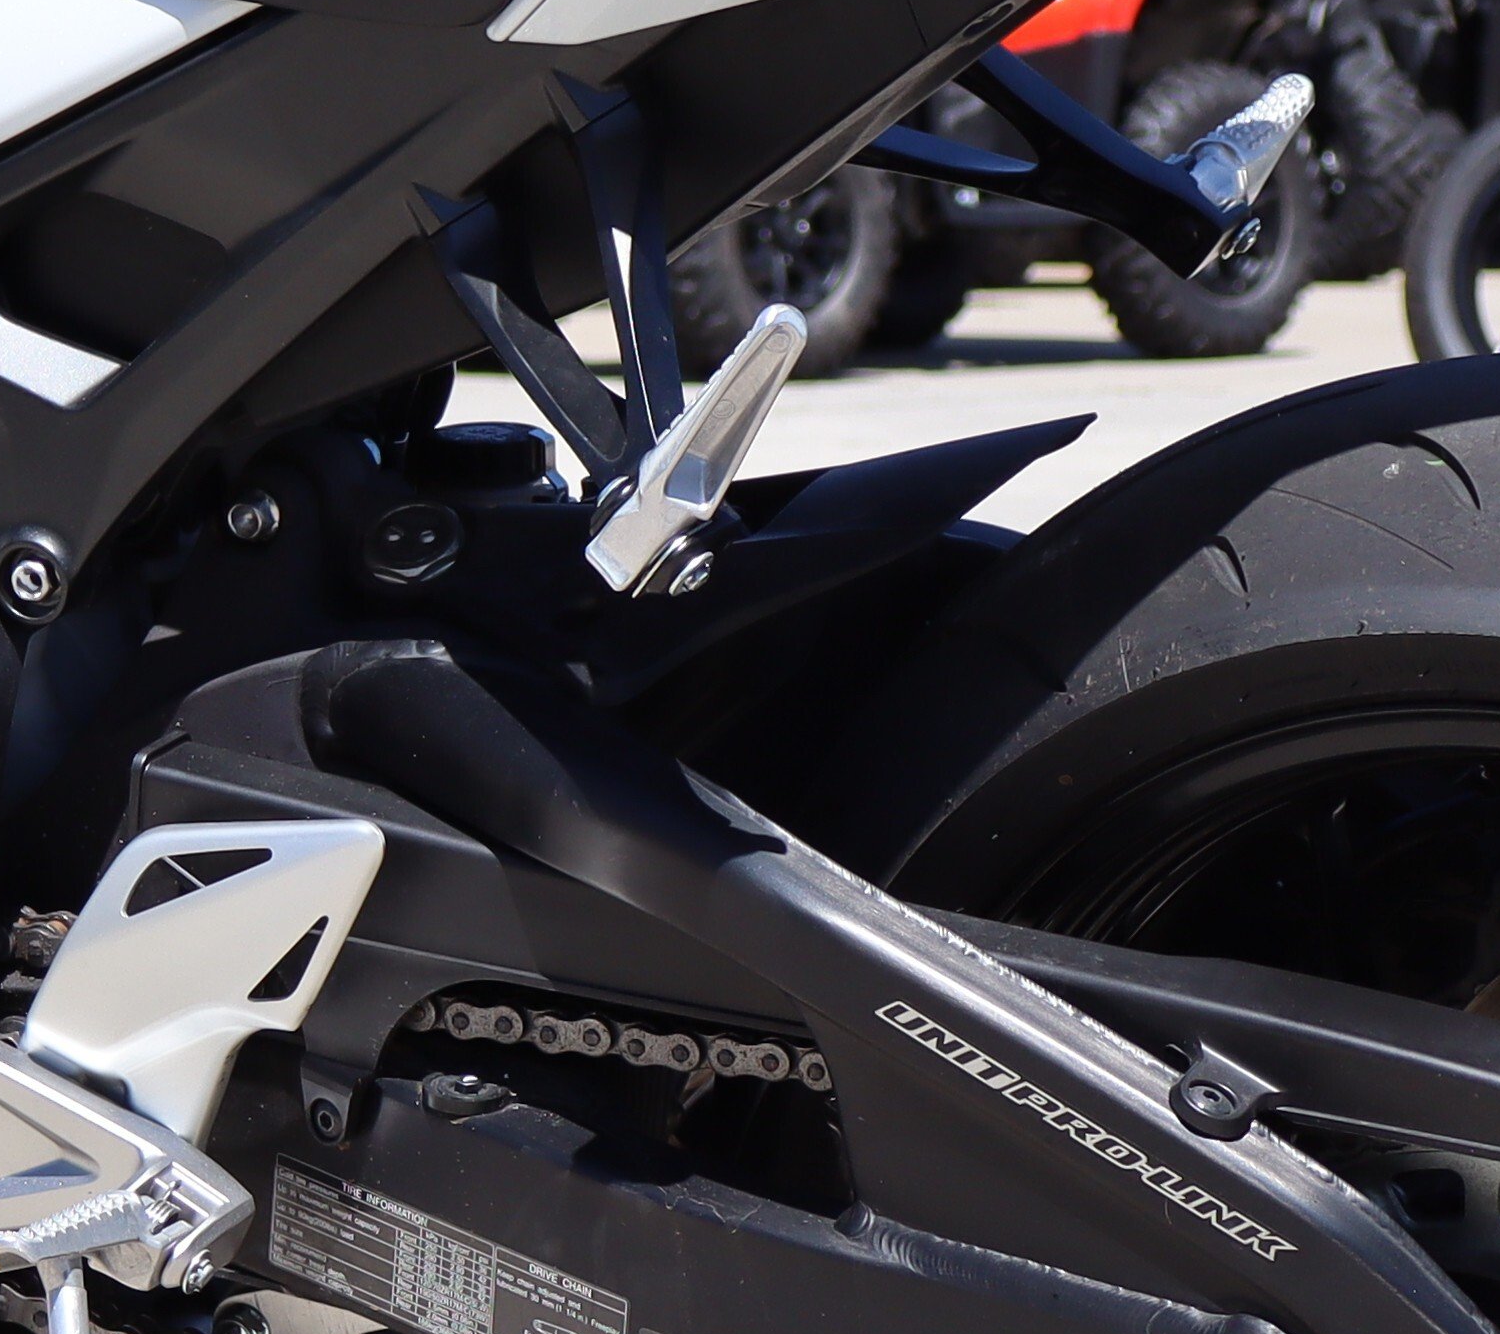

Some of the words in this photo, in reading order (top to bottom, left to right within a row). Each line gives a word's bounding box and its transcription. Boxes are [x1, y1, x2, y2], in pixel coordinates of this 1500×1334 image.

[874, 1000, 1022, 1090] UNIT
[1002, 1080, 1298, 1261] PRO-LINK
[342, 1182, 361, 1199] TIRE
[366, 1192, 427, 1227] INFORMATION
[528, 1263, 557, 1283] DRIVE
[562, 1277, 592, 1298] CHAIN
